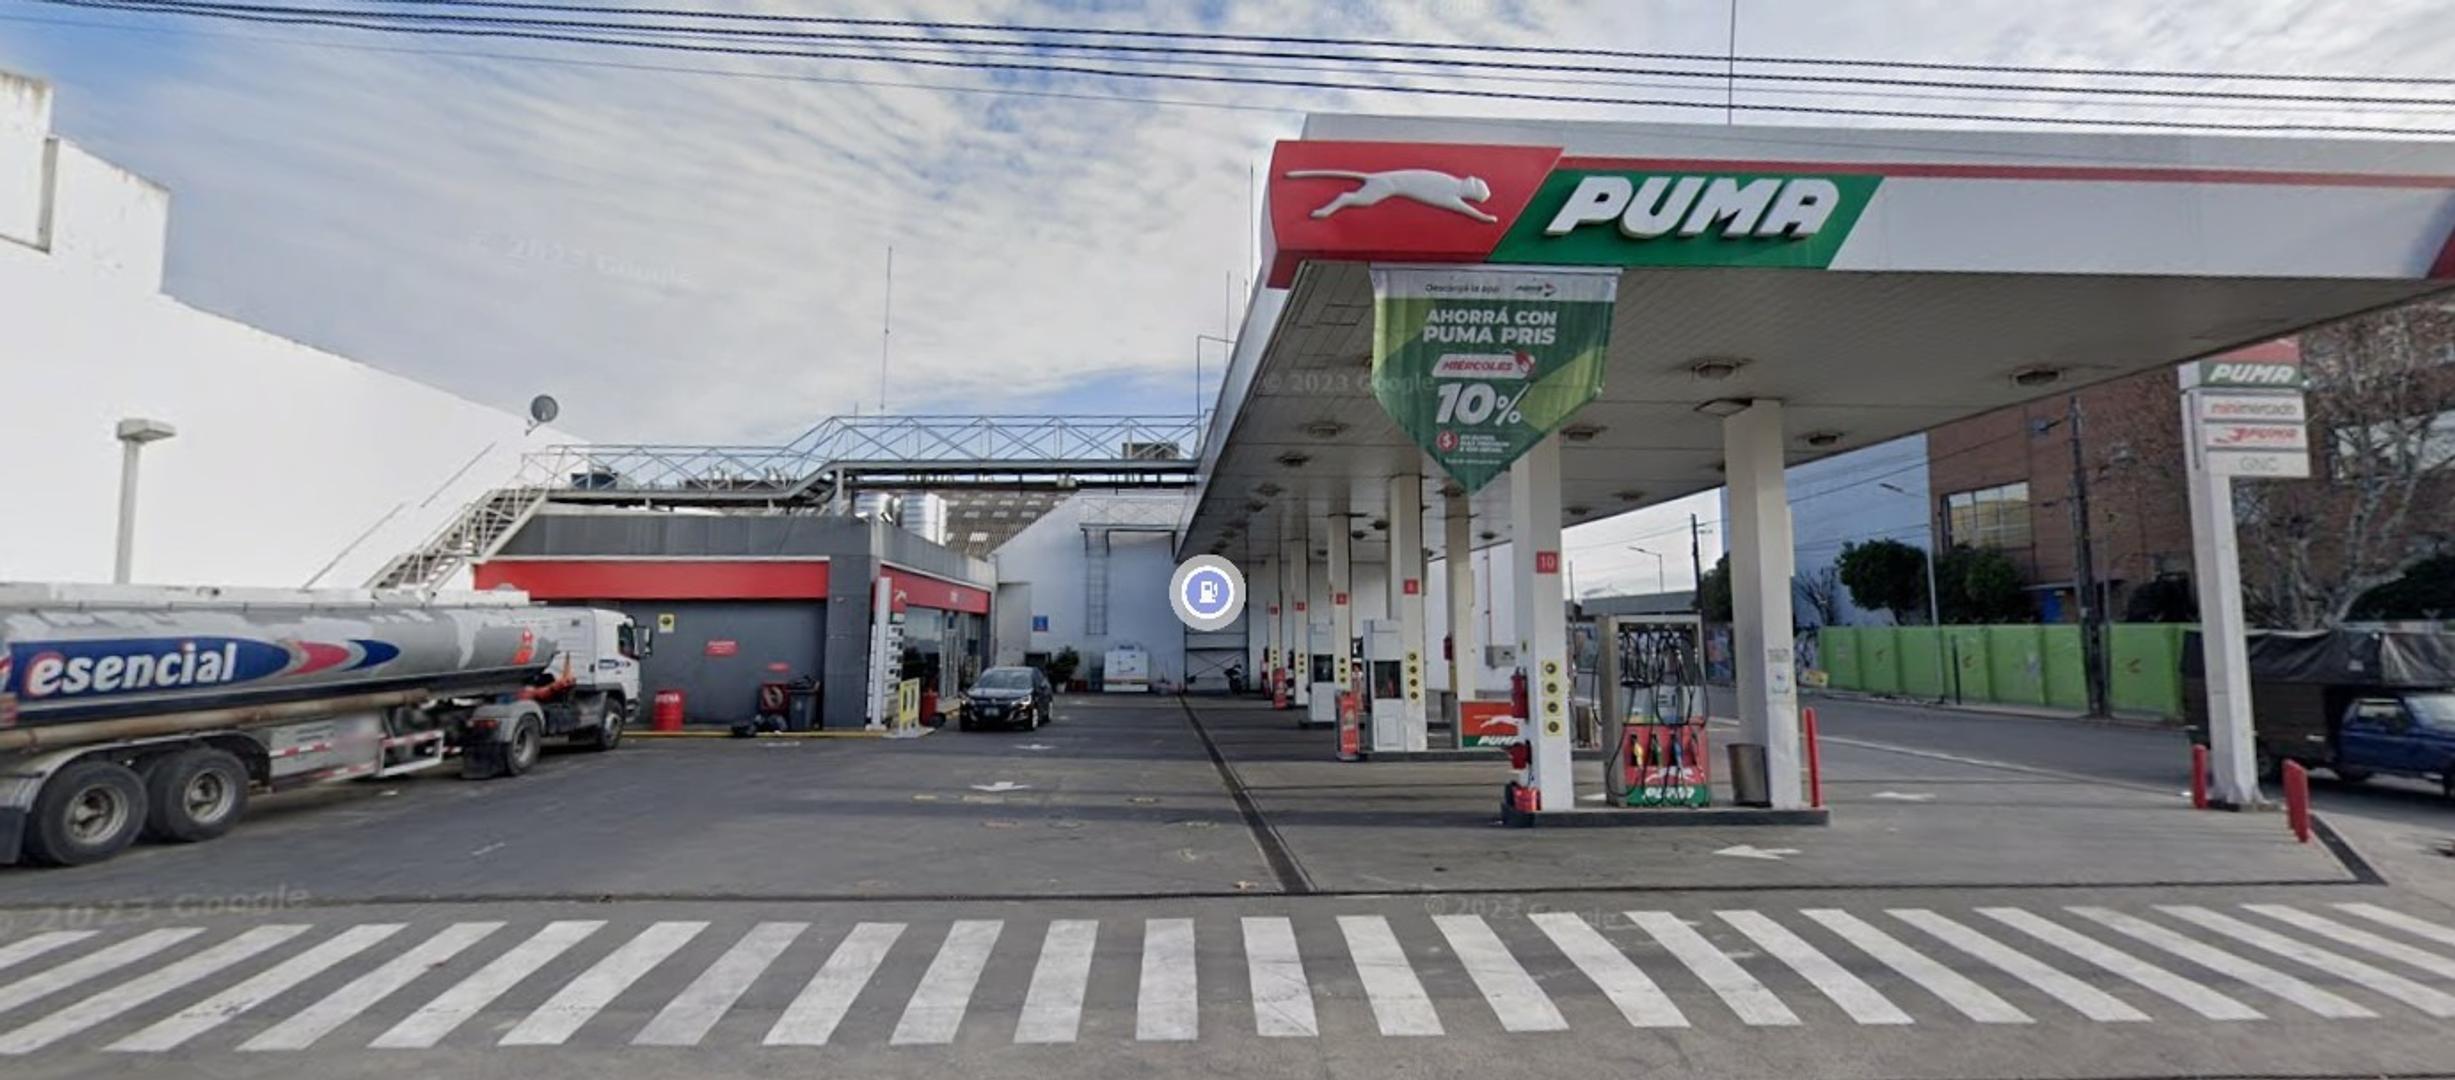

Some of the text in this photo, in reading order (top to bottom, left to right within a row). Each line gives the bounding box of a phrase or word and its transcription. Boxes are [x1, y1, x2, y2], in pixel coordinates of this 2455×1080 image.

[1545, 175, 1840, 239] PUMA
[1425, 305, 1558, 325] AHORRÁ CON
[1422, 325, 1557, 345] PUMA PRIS
[2209, 363, 2297, 383] PUMA
[1436, 382, 1530, 426] 10%
[27, 642, 238, 697] esencial
